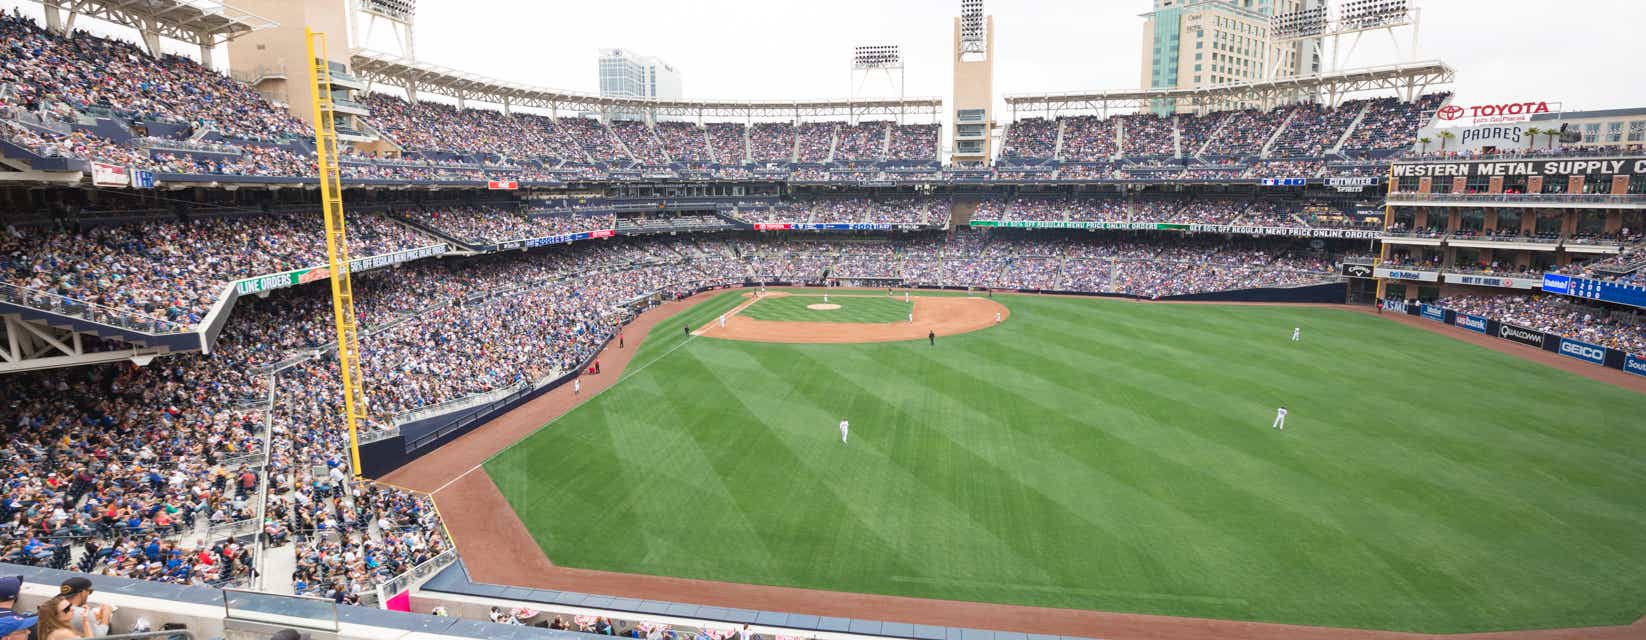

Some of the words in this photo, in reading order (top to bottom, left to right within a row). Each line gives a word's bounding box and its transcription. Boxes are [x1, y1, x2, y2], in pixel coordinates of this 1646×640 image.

[1470, 102, 1549, 117] TOYOTA
[1462, 127, 1521, 145] PADRES
[1393, 163, 1469, 176] WESTERN
[1477, 162, 1538, 175] METAL
[1544, 160, 1624, 175] SUPPLY
[1329, 177, 1372, 186] CUTWATER
[1232, 226, 1263, 234] REGULAR
[1266, 227, 1287, 235] MENU
[1313, 230, 1343, 238] ONLINE
[1345, 231, 1379, 239] ORDERS
[363, 259, 372, 270] OFF
[261, 273, 292, 290] ORDERS
[1400, 271, 1420, 280] Mitel
[1483, 278, 1500, 286] HERE
[1383, 300, 1408, 313] ASML
[1562, 342, 1603, 360] GEICO
